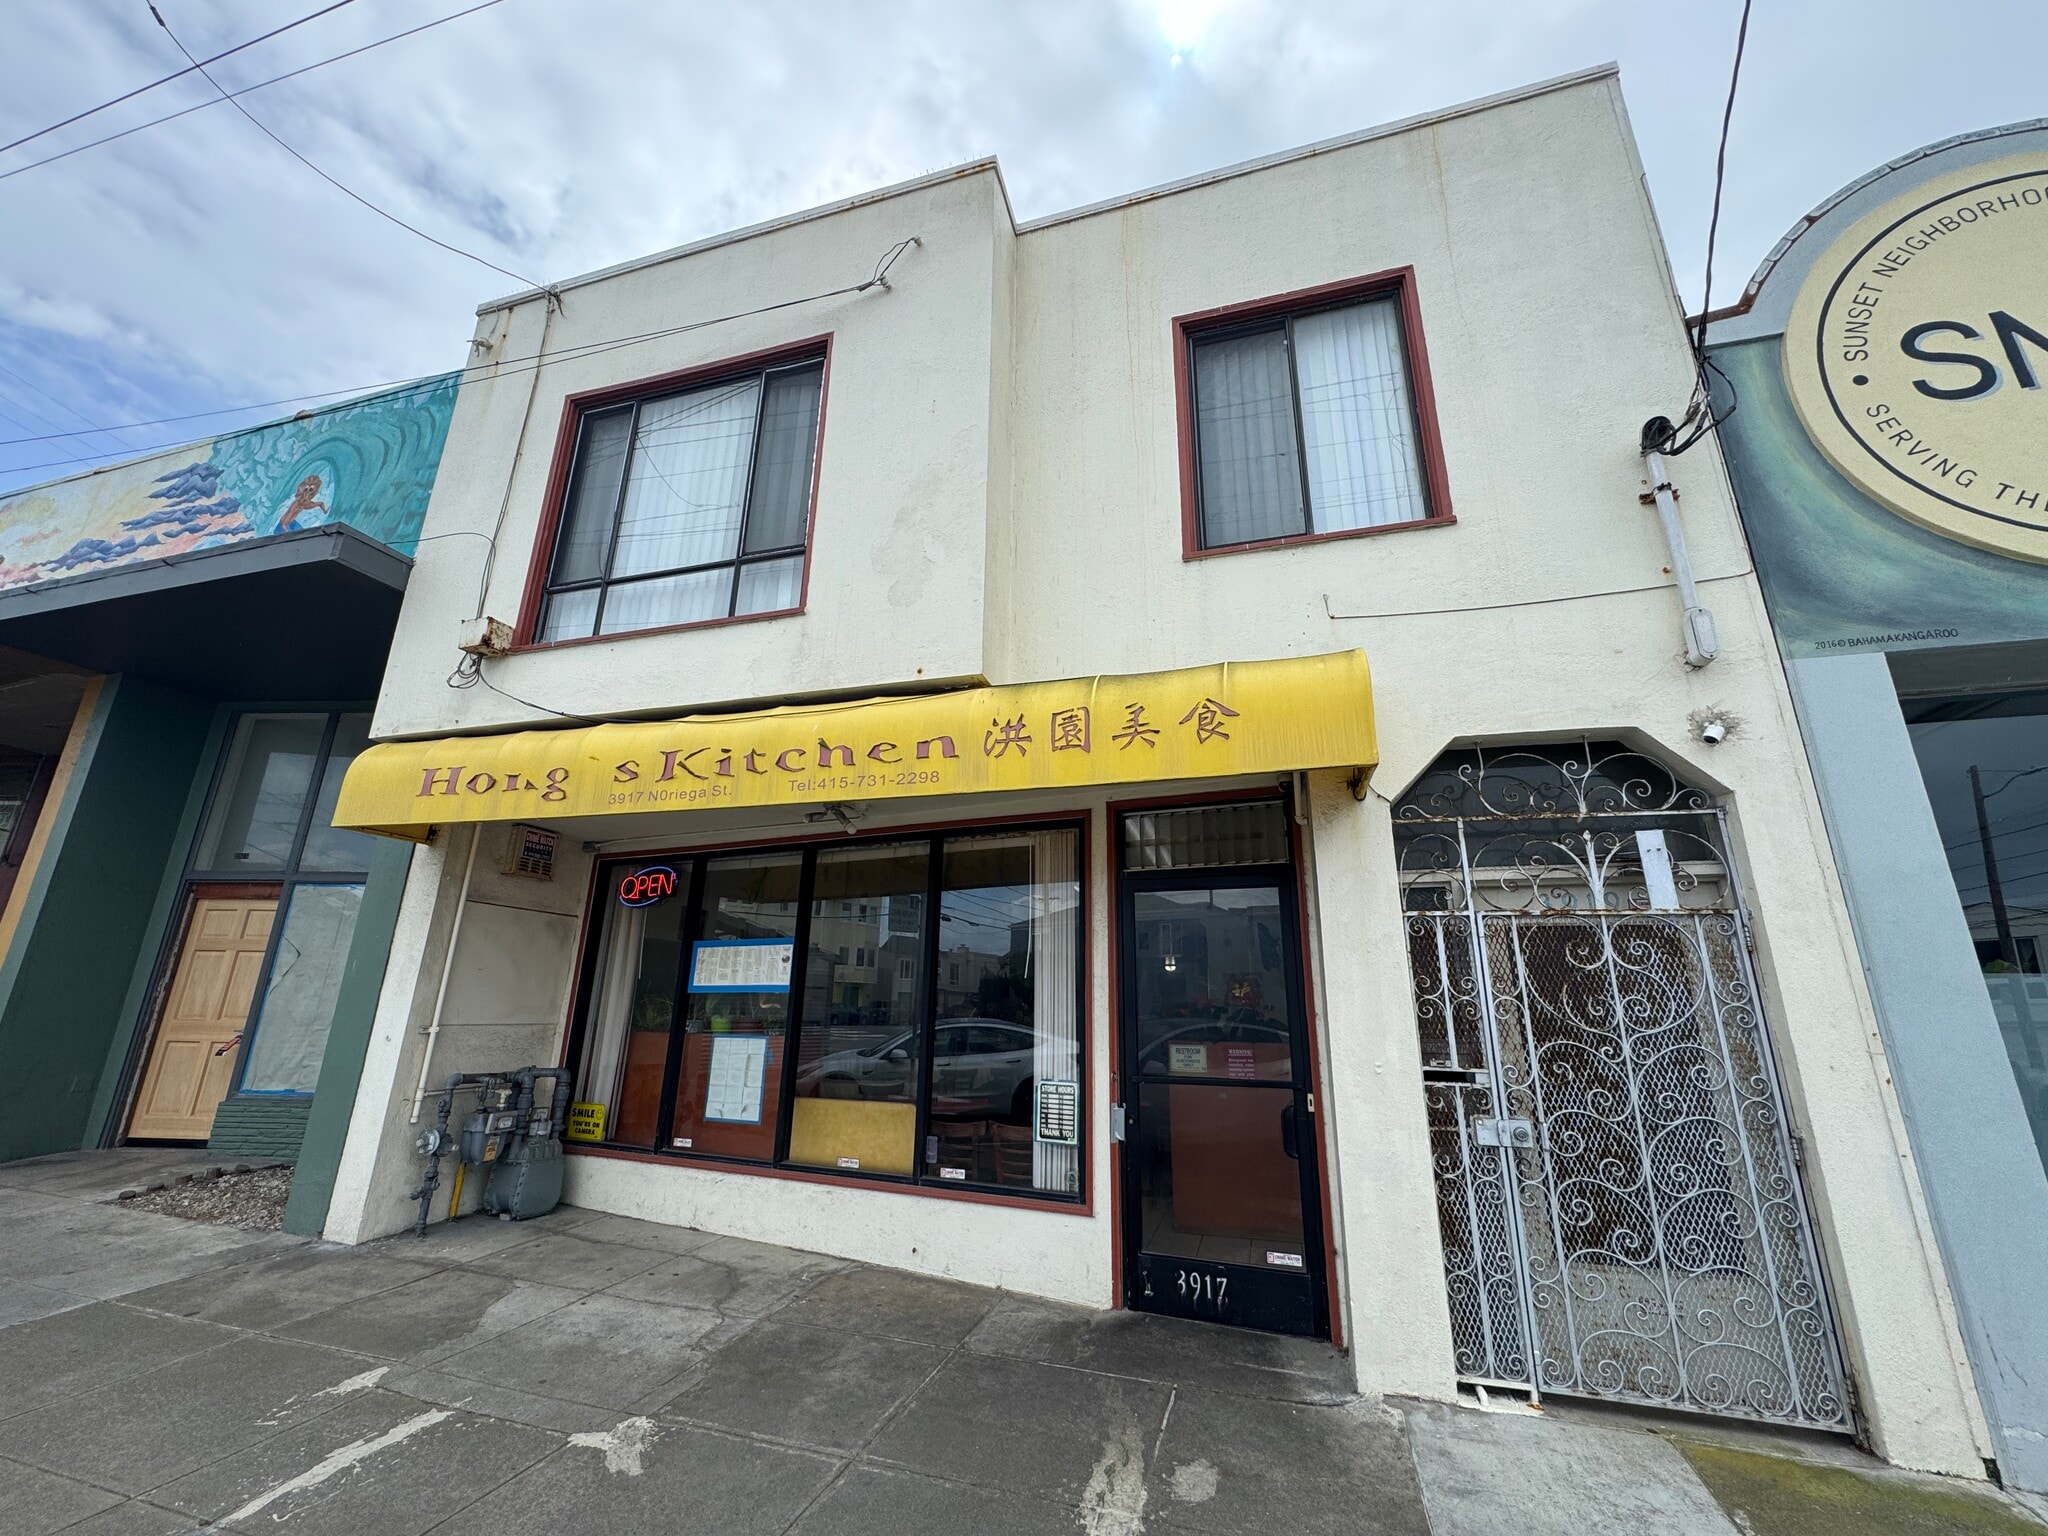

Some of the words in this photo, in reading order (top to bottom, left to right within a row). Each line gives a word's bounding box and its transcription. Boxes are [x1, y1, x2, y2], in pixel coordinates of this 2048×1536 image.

[1843, 281, 1884, 362] SUNSET
[1876, 187, 2048, 279] NEIGHBORHO
[1866, 402, 1978, 489] SERVING
[1847, 628, 1960, 648] BAHAMAKANGAROO
[983, 697, 1240, 759] 洪園美食
[655, 735, 960, 783] Kitchen
[788, 770, 940, 793] Tel:415-731-2298
[608, 790, 643, 805] 3917
[711, 784, 732, 797] St.
[525, 842, 552, 852] SECURITY
[620, 873, 675, 899] OPEN
[1041, 1085, 1057, 1093] STORE
[1058, 1086, 1074, 1094] HOURS
[571, 1107, 596, 1119] SMILE
[574, 1127, 595, 1136] CAMERA
[1041, 1128, 1060, 1137] THANK
[1062, 1130, 1074, 1138] YOU
[1177, 1270, 1228, 1304] 3917
